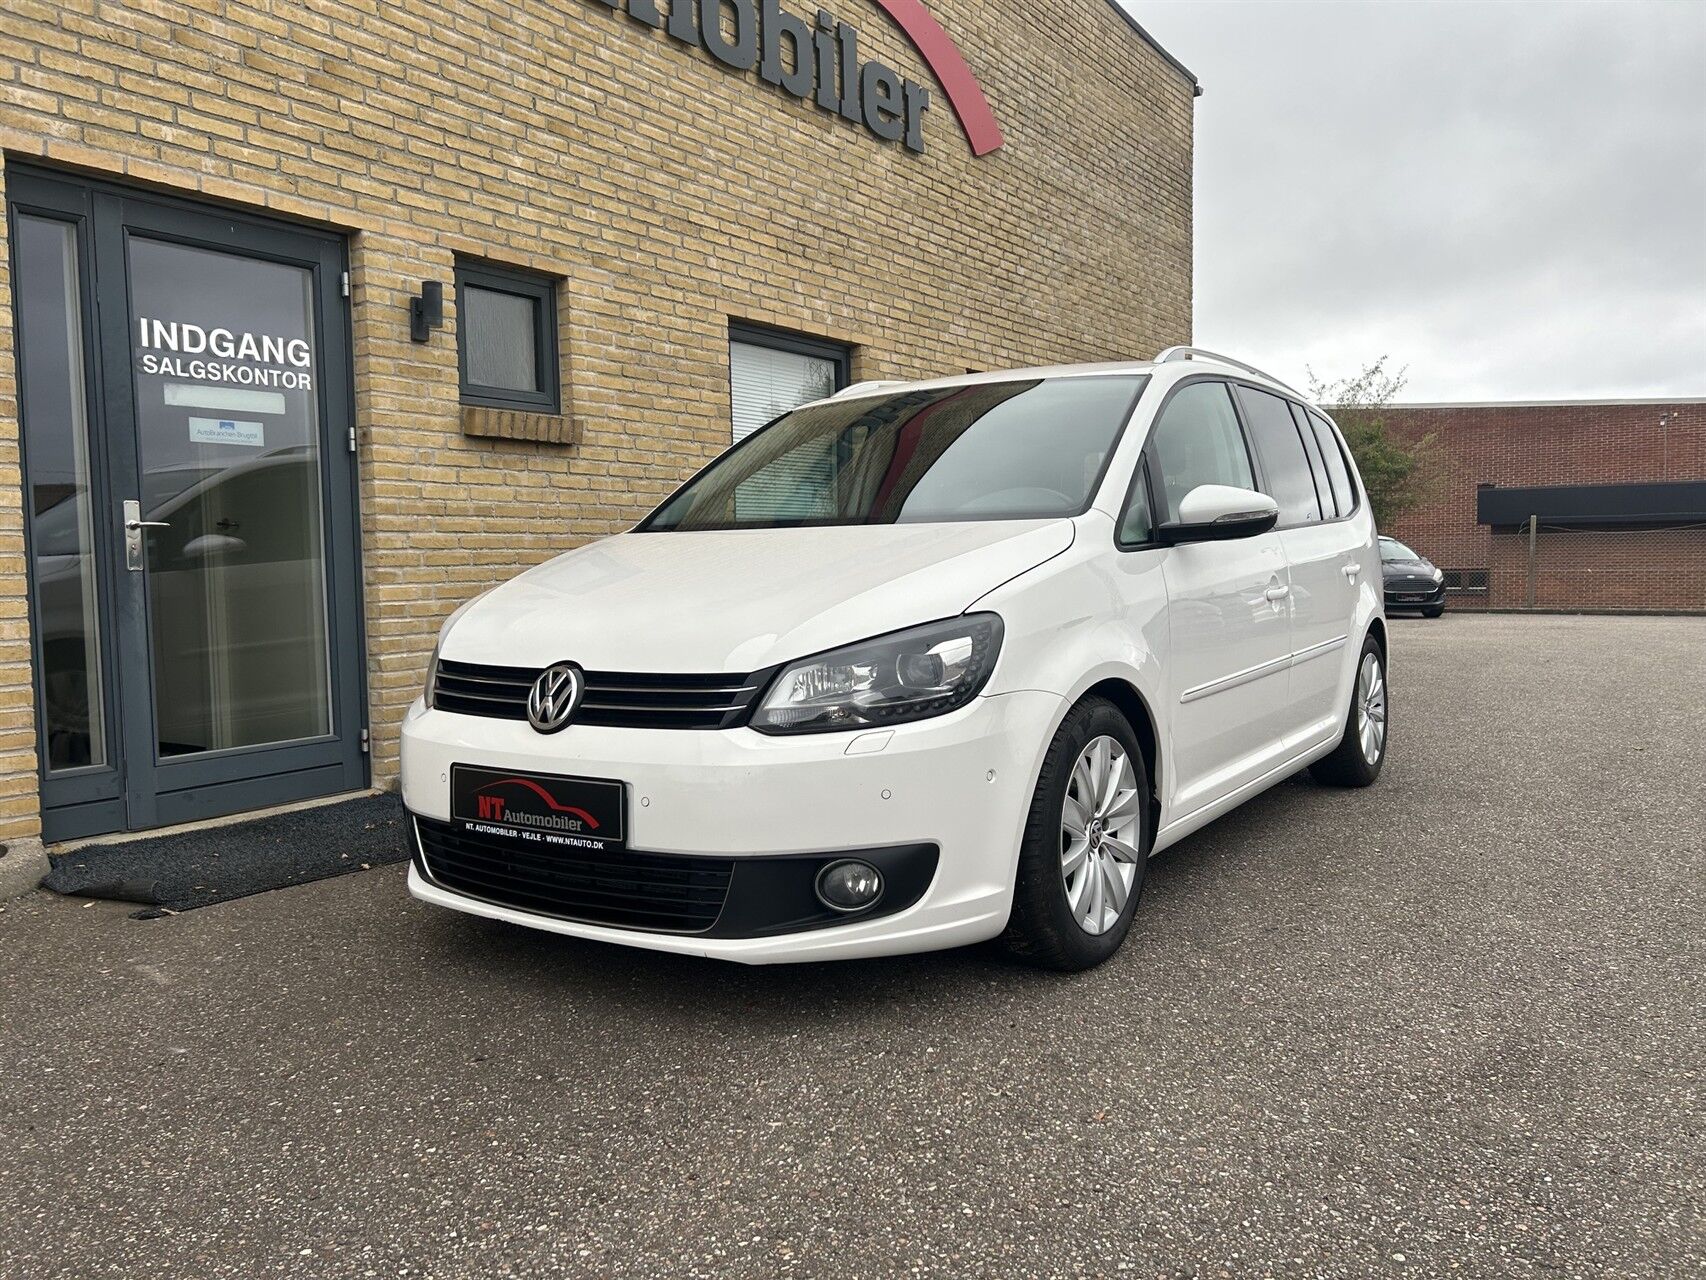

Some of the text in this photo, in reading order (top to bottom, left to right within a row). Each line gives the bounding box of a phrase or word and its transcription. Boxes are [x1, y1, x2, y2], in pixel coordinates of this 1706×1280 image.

[590, 0, 929, 153] obiler
[140, 317, 311, 368] INDGANG
[143, 354, 312, 391] SALGSKONTOR
[478, 795, 582, 831] NT Automobiler
[465, 823, 475, 831] NT.
[475, 824, 518, 838] AUTOMOBILER
[521, 831, 542, 842] VEJLE
[545, 835, 604, 850] WWW.NTAUTO.DK
